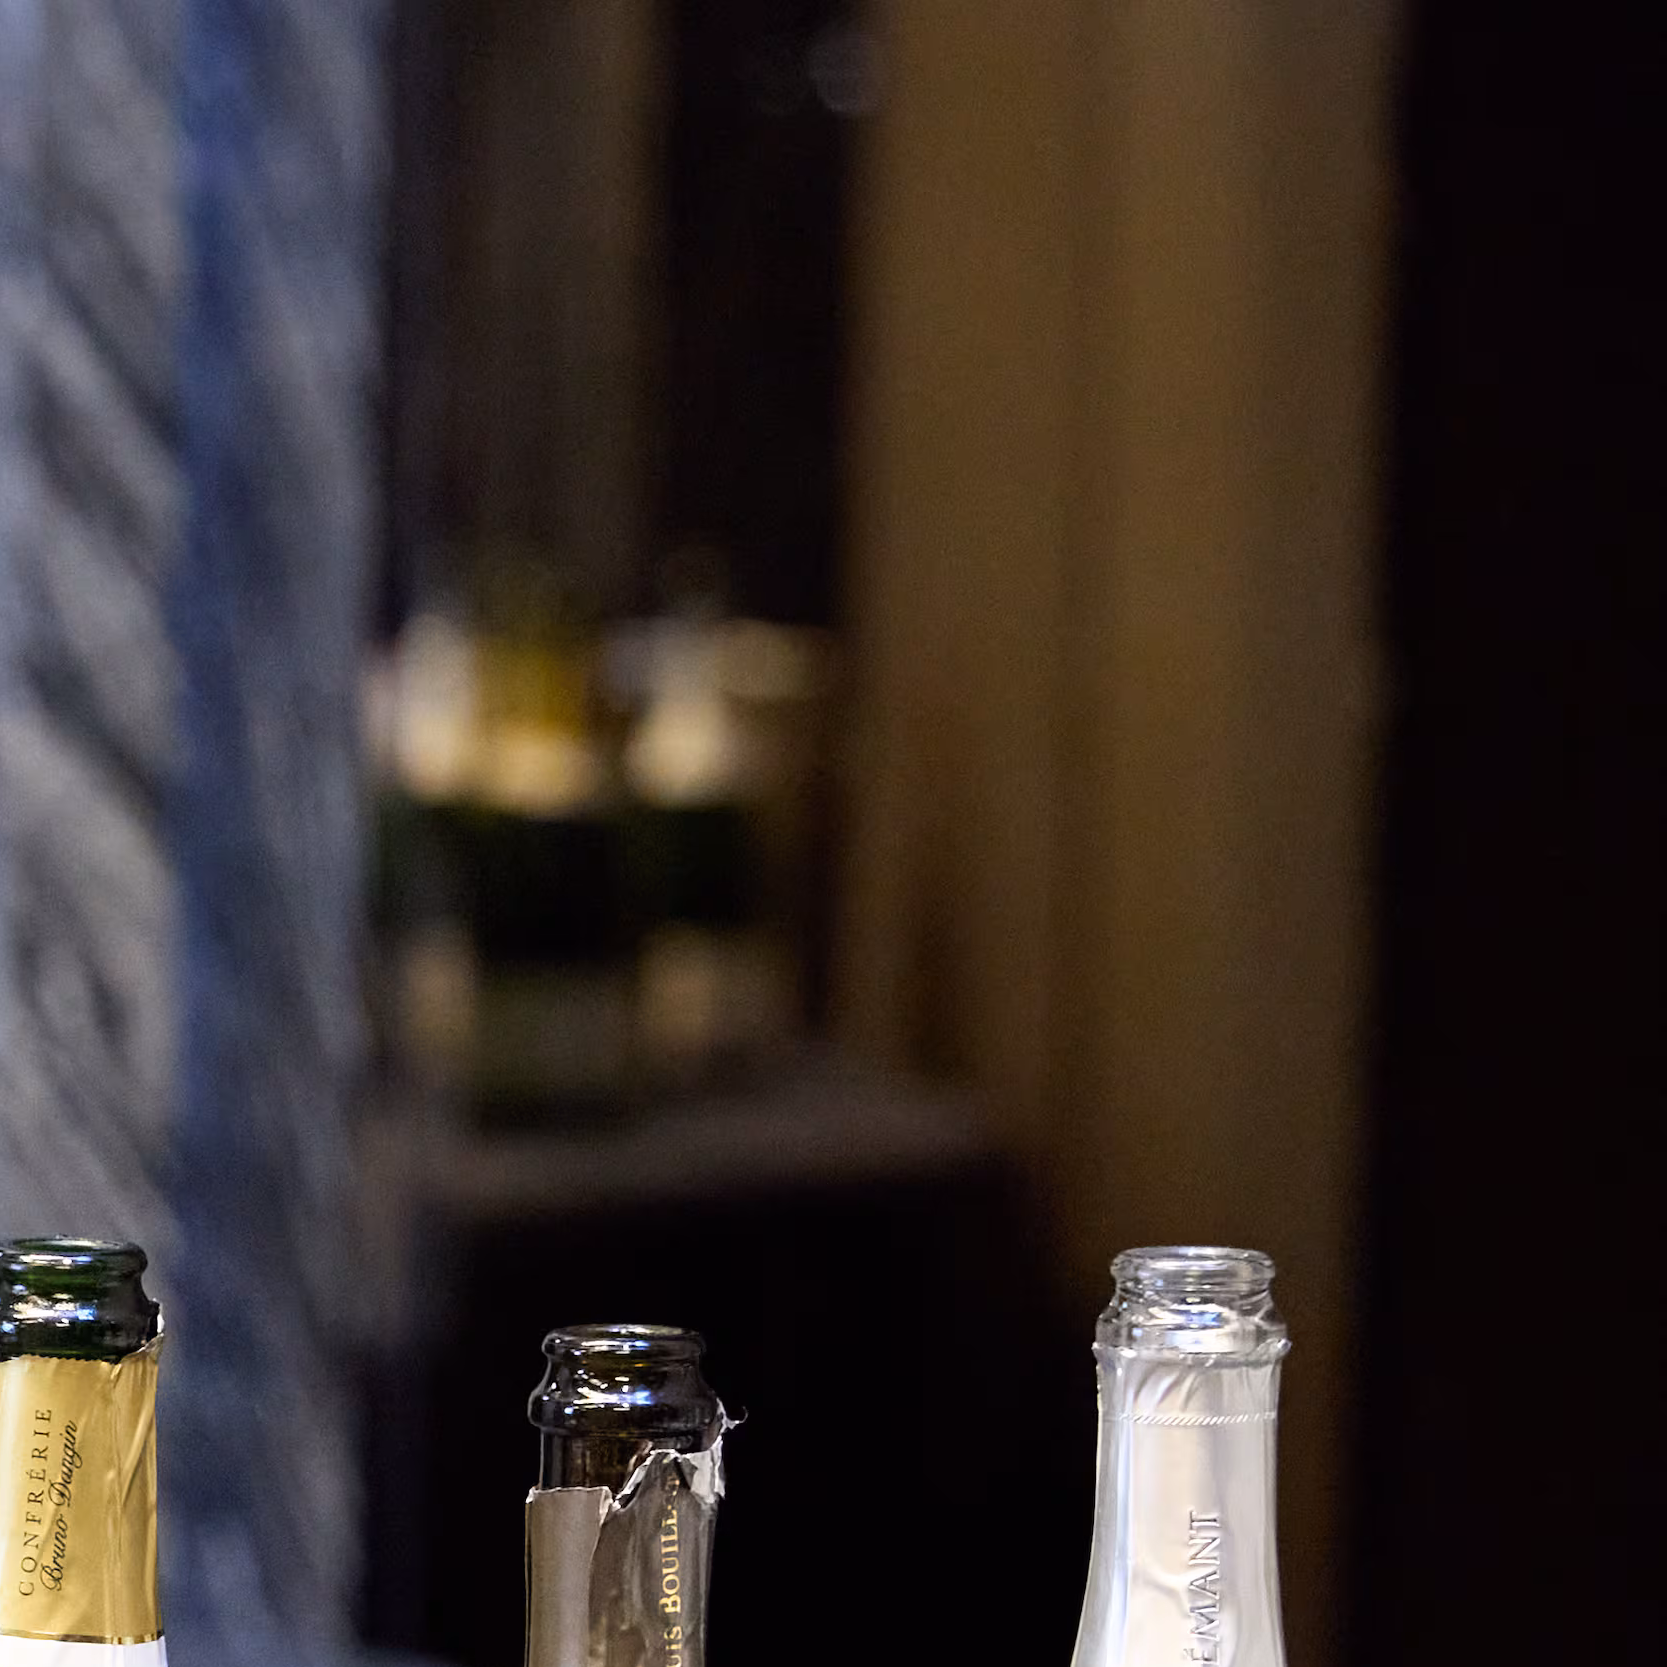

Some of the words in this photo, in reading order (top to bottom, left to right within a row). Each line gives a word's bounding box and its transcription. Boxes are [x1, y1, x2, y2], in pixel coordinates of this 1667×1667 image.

[18, 1409, 52, 1597] CONFRÉRIE
[48, 1420, 83, 1508] Dangin
[40, 1514, 68, 1591] Bruno
